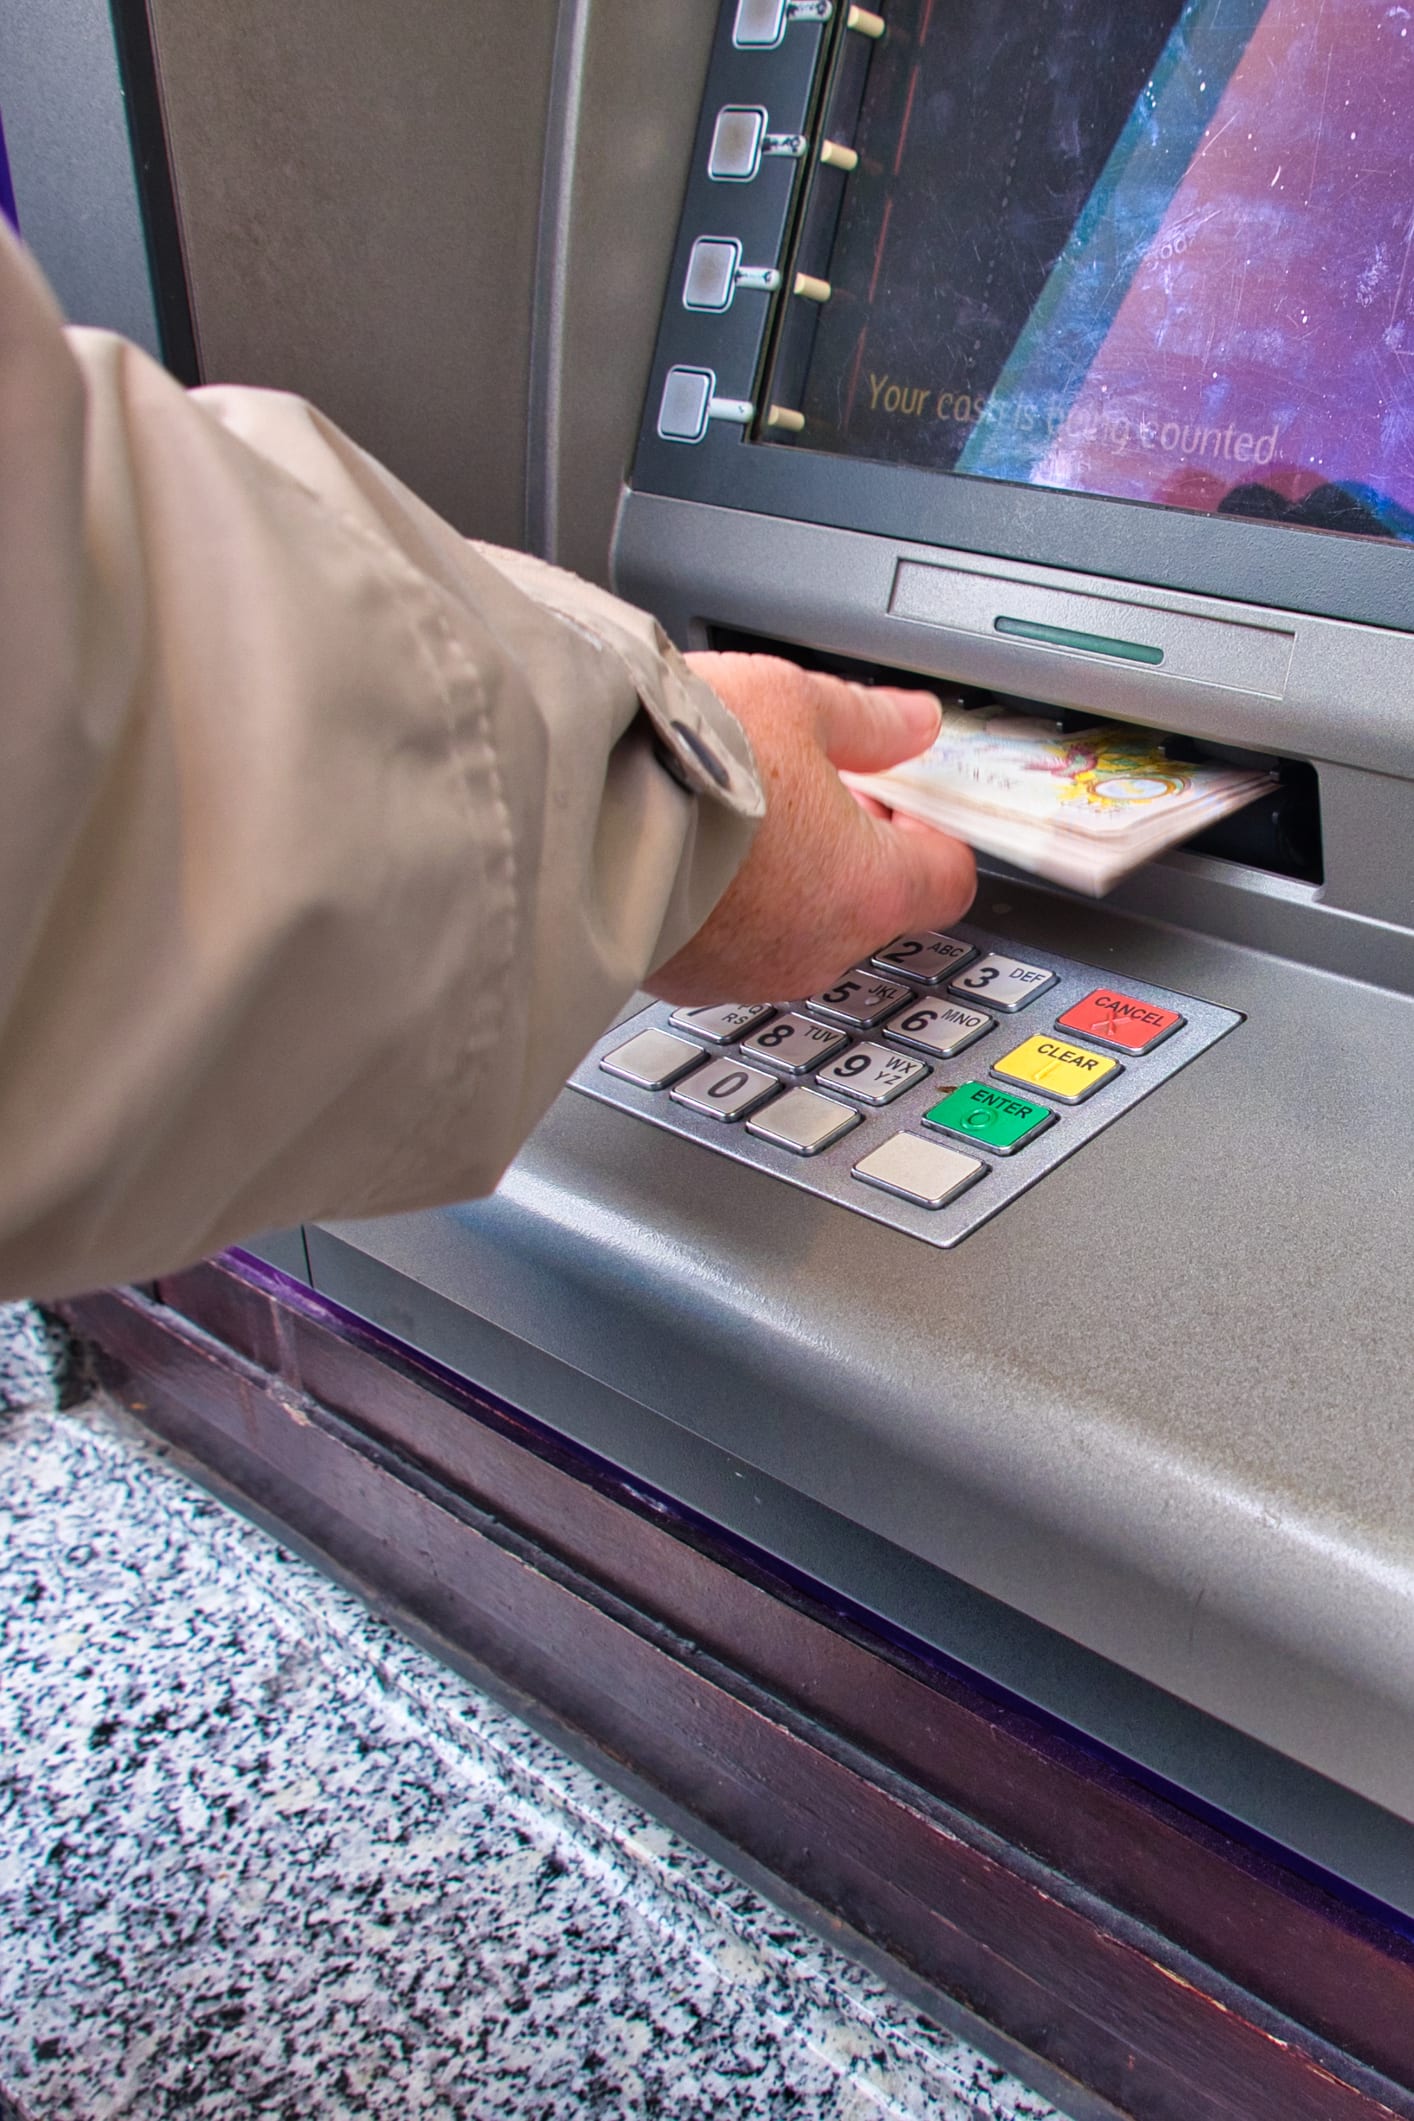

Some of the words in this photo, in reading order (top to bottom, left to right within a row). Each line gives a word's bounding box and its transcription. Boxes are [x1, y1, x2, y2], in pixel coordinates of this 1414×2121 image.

[869, 372, 931, 416] Your
[1140, 419, 1280, 465] counted
[886, 940, 924, 964] 2
[928, 941, 965, 959] ABC
[963, 966, 1001, 989] 3
[1008, 967, 1047, 984] DEF
[822, 981, 862, 1003] 5
[868, 983, 898, 1000] JKL
[721, 1011, 750, 1026] RS
[900, 1009, 939, 1032] 6
[940, 1008, 982, 1028] MNO
[1094, 995, 1166, 1028] CANCEL
[756, 1024, 796, 1048] 8
[803, 1025, 839, 1043] TUV
[833, 1053, 872, 1078] 9
[884, 1056, 919, 1075] WX
[1037, 1042, 1100, 1072] CLEAR
[707, 1071, 750, 1099] 0
[873, 1069, 903, 1086] YZ
[970, 1088, 1034, 1120] ENTER
